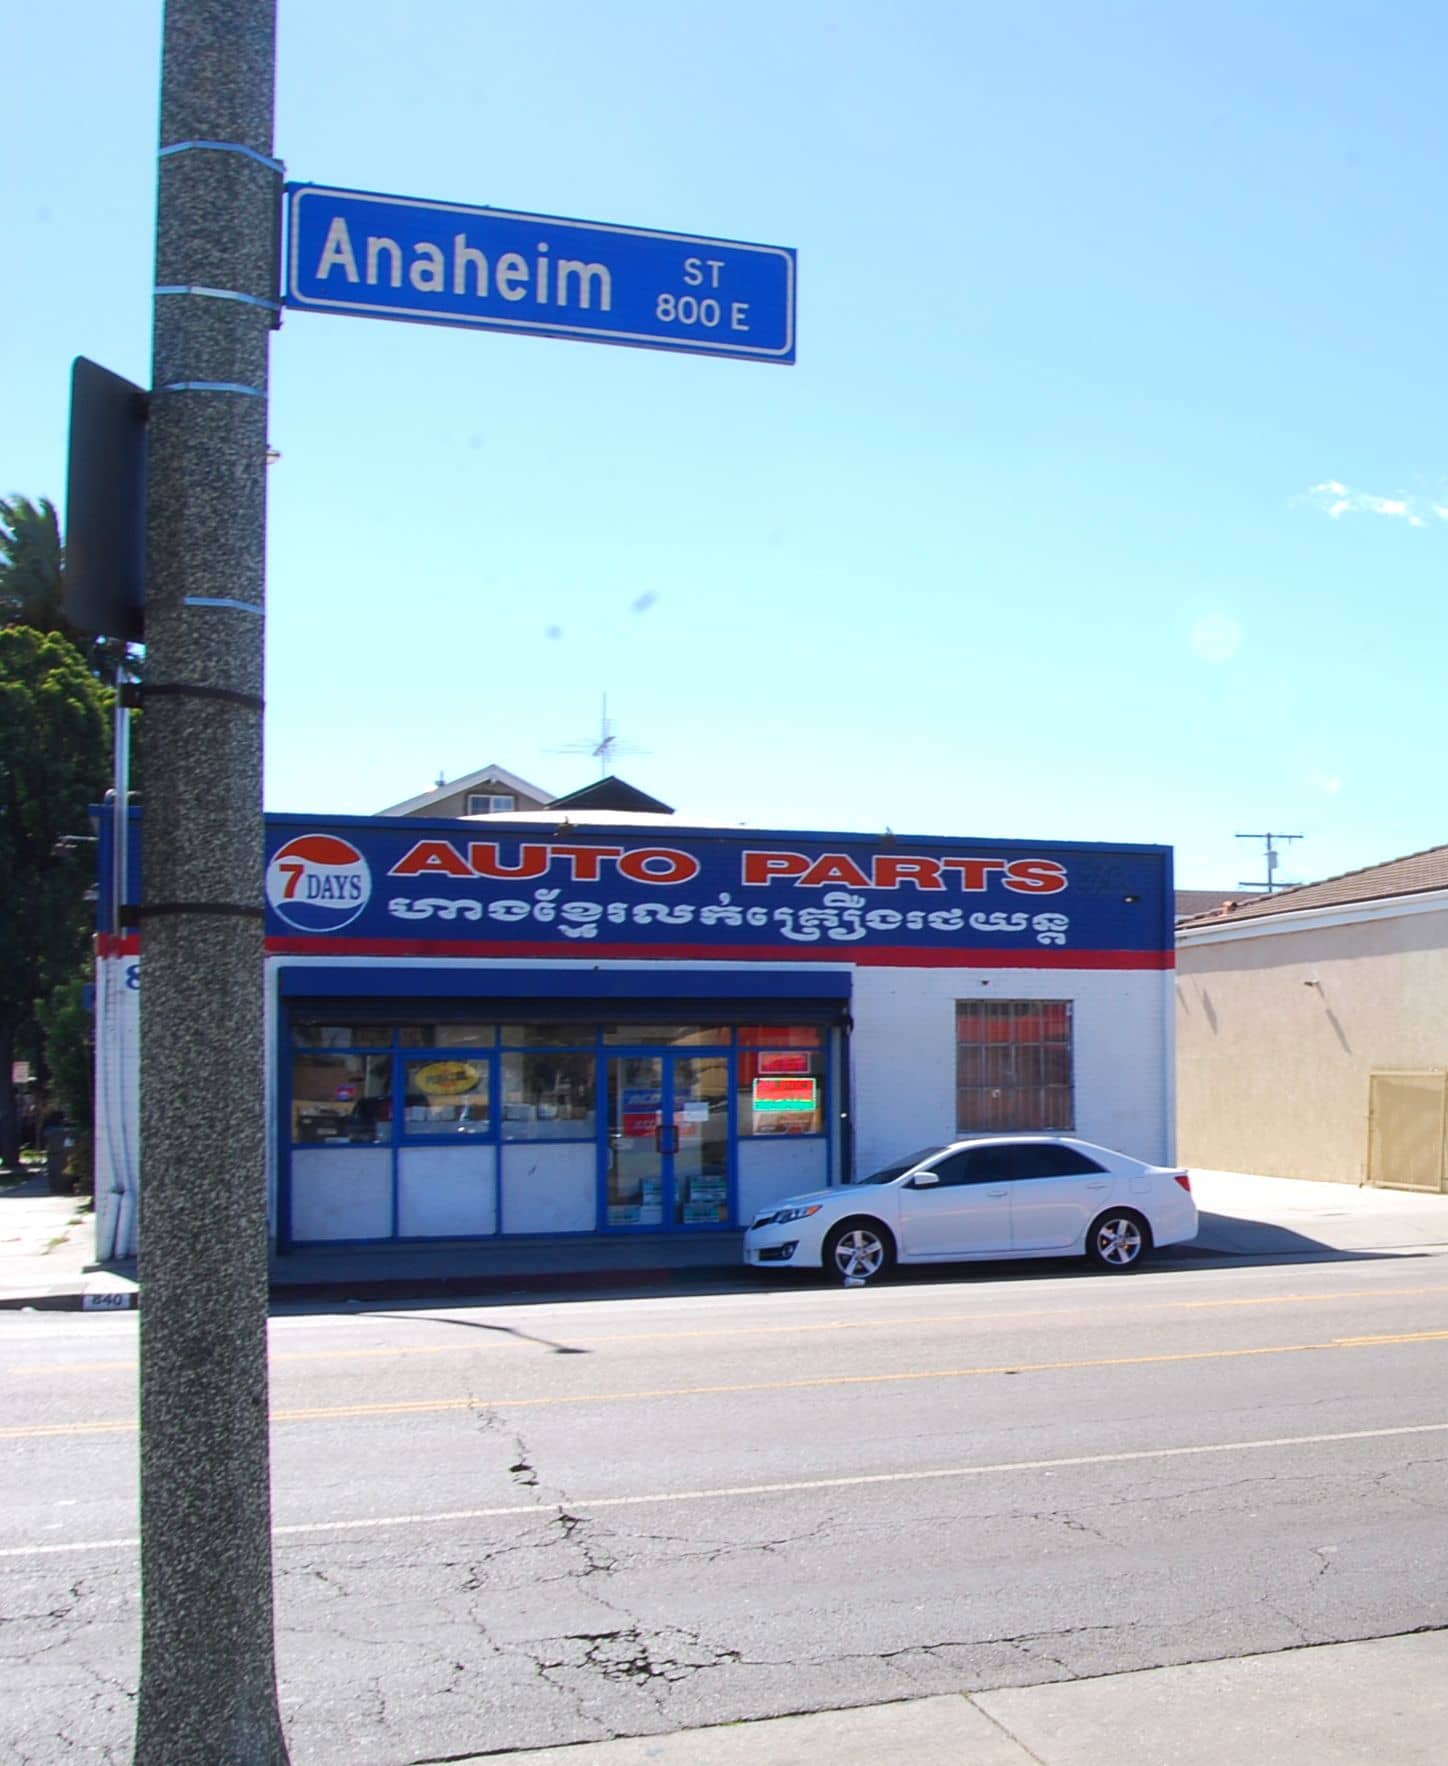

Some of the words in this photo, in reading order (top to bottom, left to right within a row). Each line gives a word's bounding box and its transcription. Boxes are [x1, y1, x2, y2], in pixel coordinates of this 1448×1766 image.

[315, 216, 612, 312] Anaheim
[682, 257, 726, 289] ST
[655, 293, 721, 329] 800
[730, 303, 750, 332] E
[278, 863, 305, 899] 7
[306, 874, 362, 901] DAYS
[386, 839, 701, 886] AUTO
[740, 850, 1069, 895] PARTS
